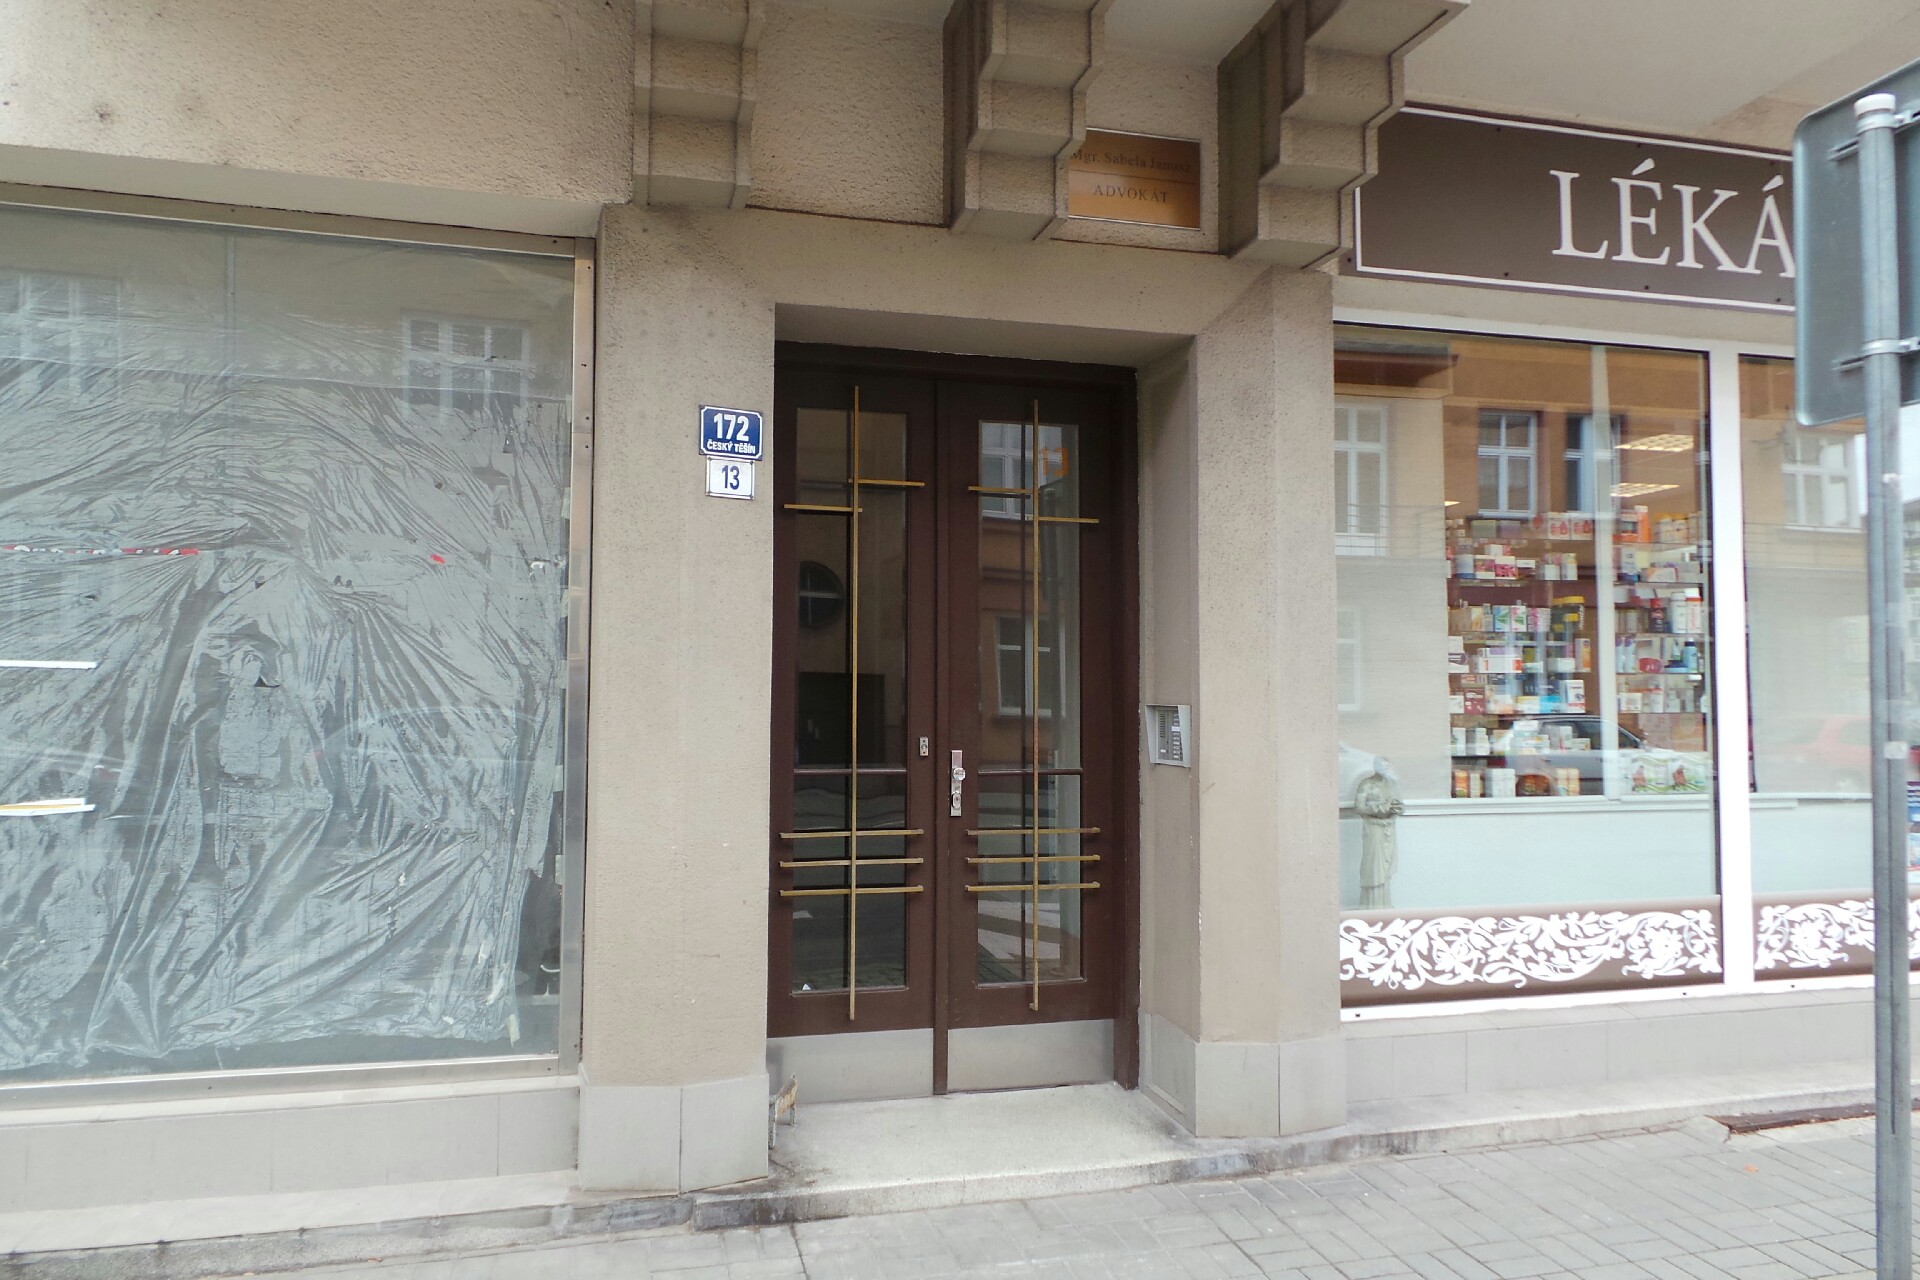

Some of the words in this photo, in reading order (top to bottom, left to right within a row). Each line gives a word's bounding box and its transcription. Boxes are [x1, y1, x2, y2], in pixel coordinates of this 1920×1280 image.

[1093, 185, 1169, 203] ADVOKÁT
[713, 412, 750, 441] 172
[707, 438, 733, 451] ČESKÝ
[734, 442, 756, 455] TĚŠÍN
[1041, 447, 1069, 477] 13
[722, 464, 740, 490] 13
